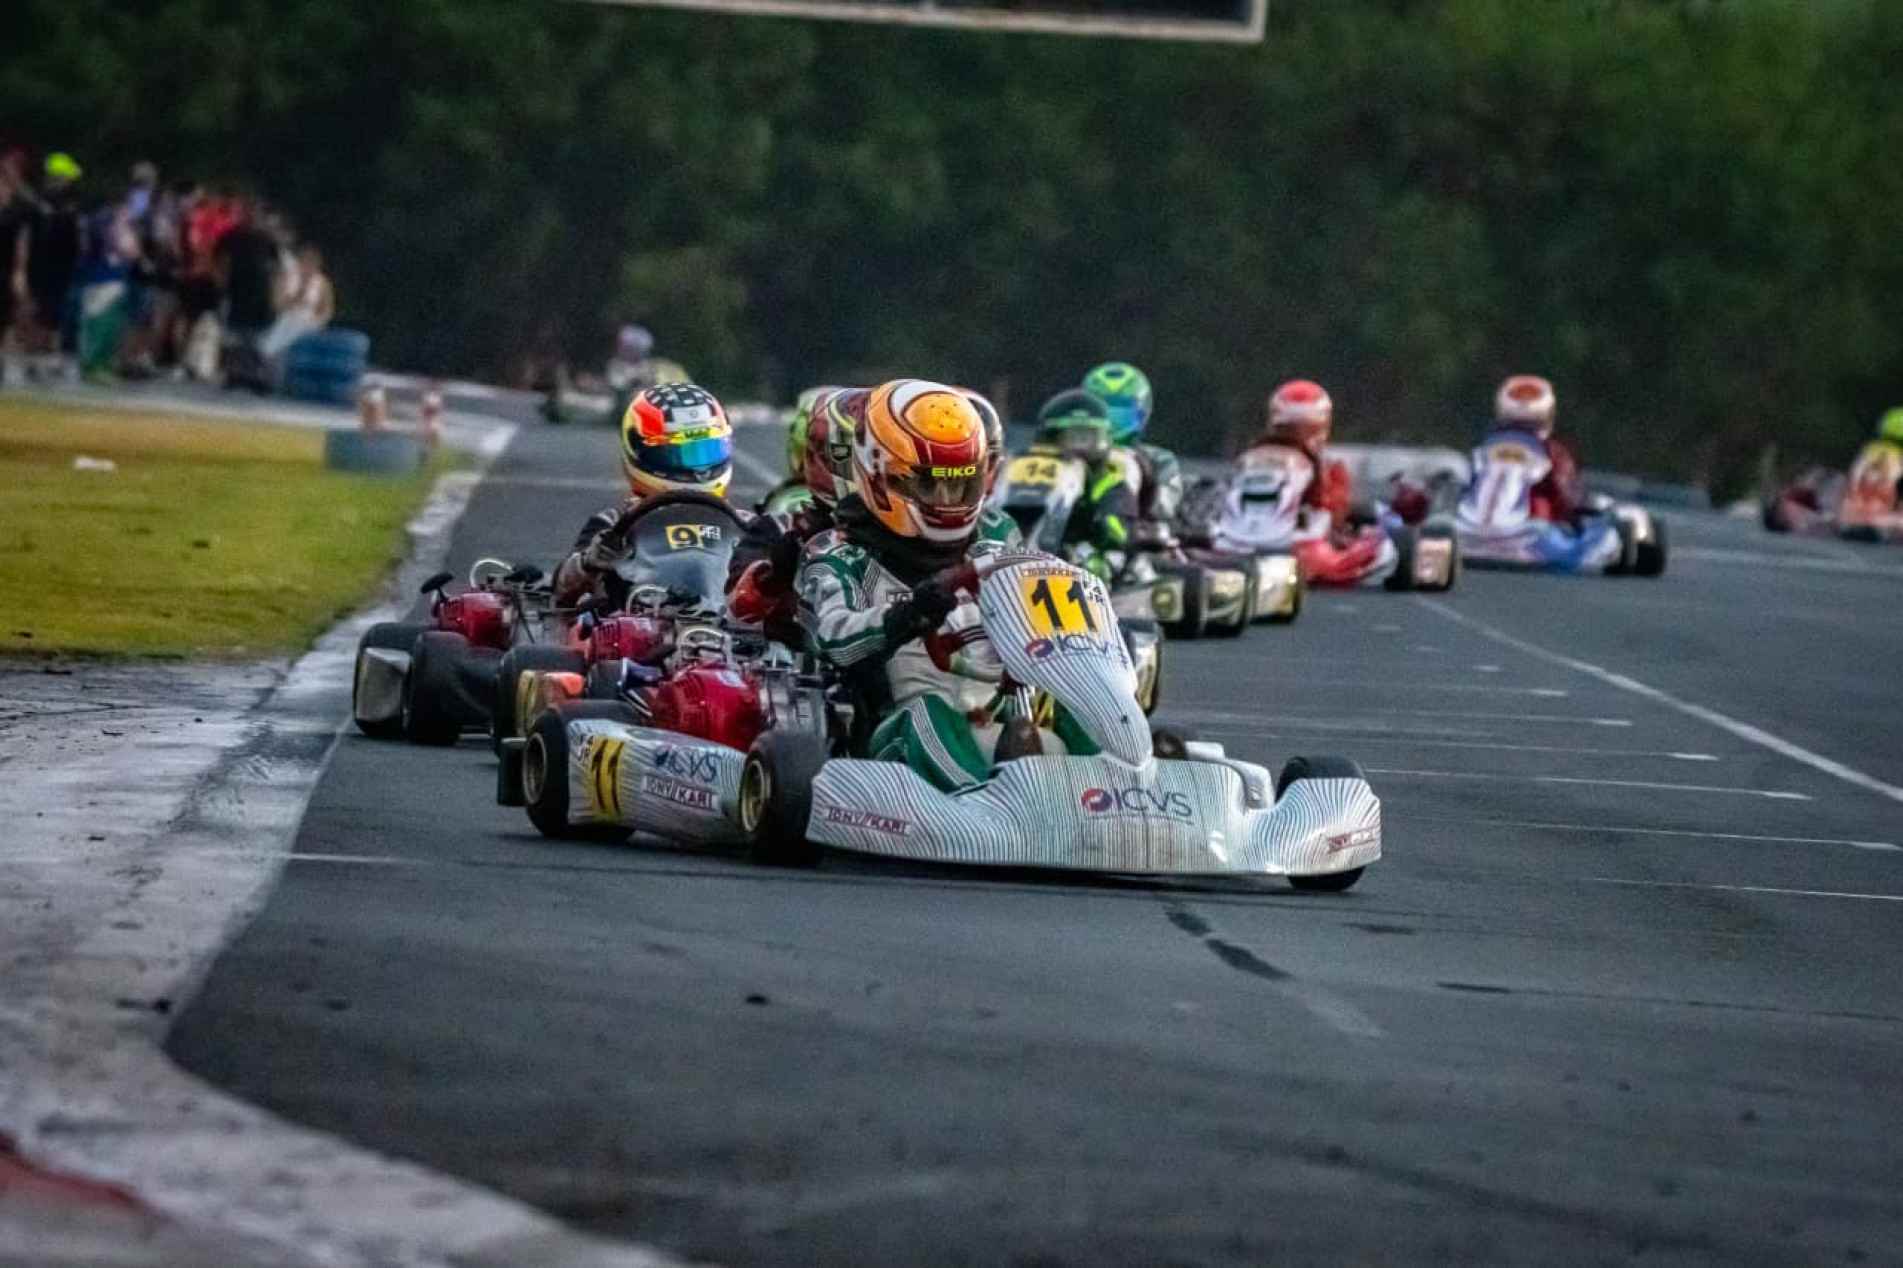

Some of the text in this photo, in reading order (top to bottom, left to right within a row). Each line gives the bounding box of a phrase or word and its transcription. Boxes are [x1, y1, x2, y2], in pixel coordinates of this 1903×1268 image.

[931, 466, 976, 477] EIKO
[1030, 578, 1098, 632] 11
[591, 738, 625, 815] 11
[1113, 787, 1193, 817] ICVS
